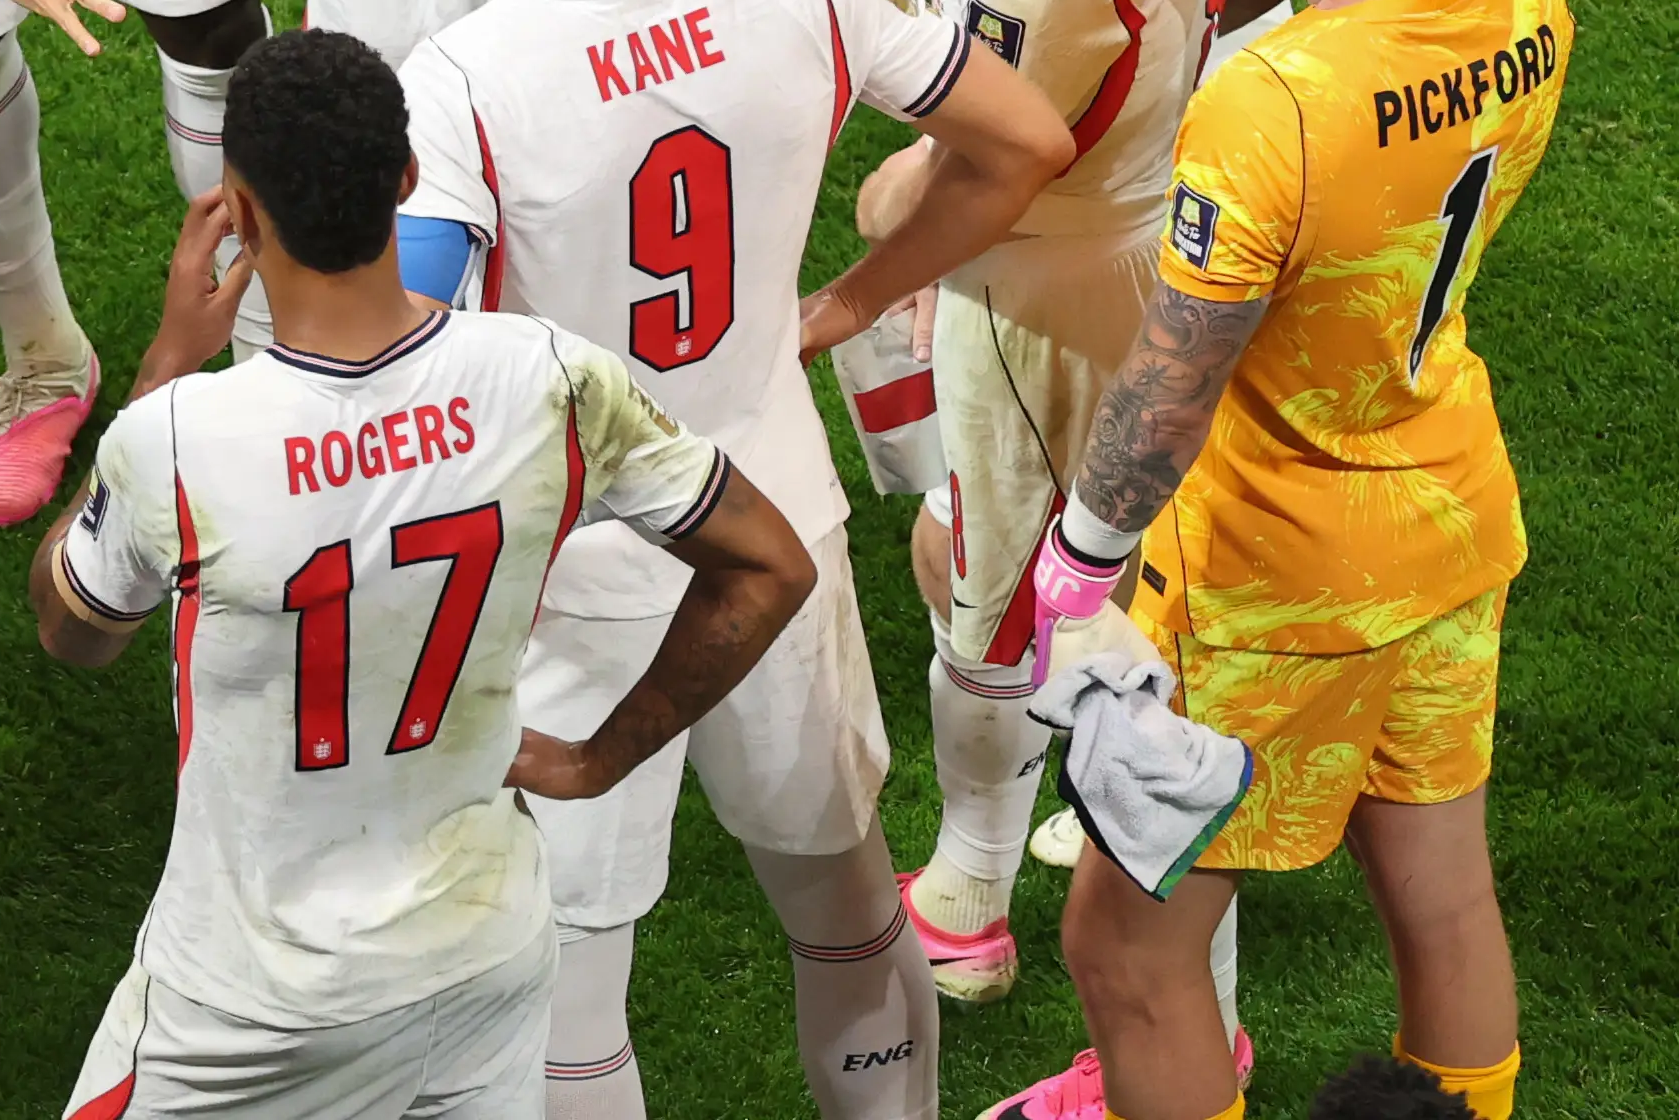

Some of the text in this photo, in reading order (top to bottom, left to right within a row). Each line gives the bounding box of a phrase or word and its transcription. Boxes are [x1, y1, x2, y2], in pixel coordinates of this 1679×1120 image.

[586, 6, 726, 103] KANE
[1373, 23, 1557, 149] PICKFORD
[629, 124, 735, 373] 9
[1405, 145, 1501, 391] 1
[283, 396, 476, 496] ROGERS
[281, 500, 504, 772] 17
[842, 1040, 914, 1072] ENG
